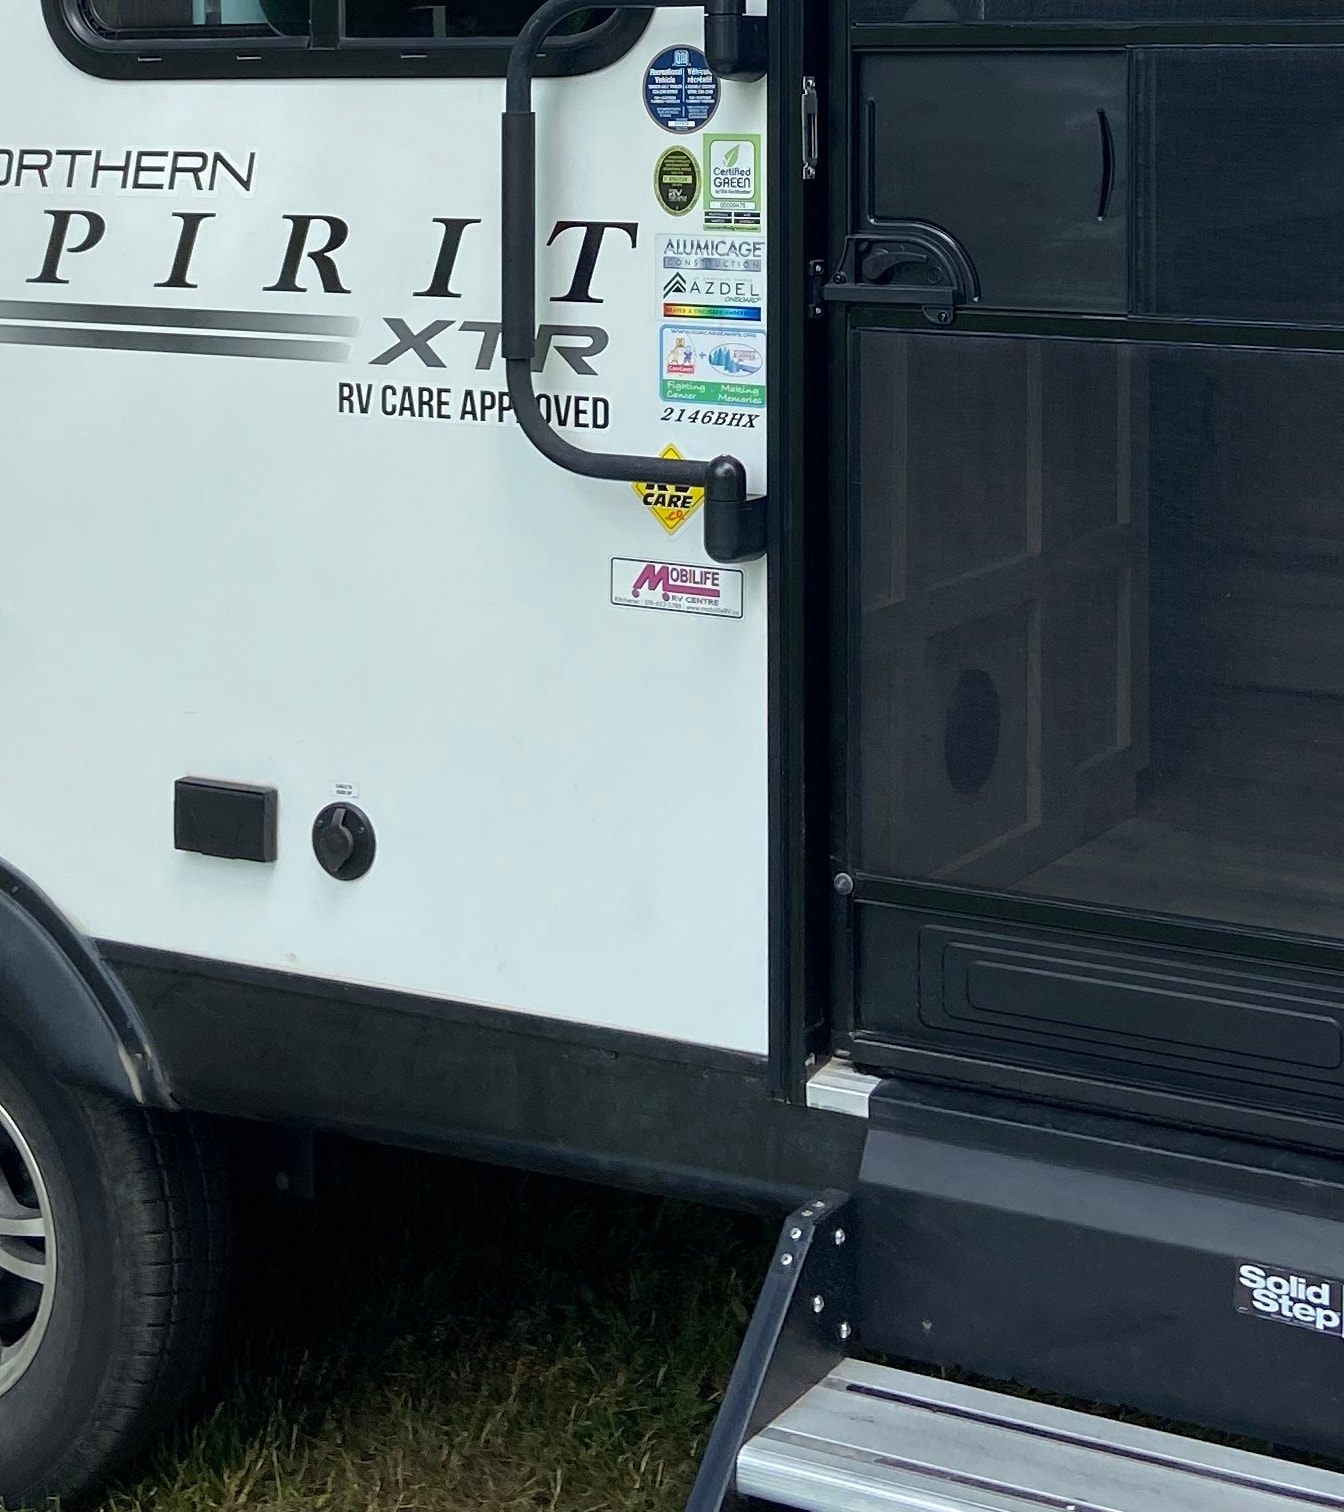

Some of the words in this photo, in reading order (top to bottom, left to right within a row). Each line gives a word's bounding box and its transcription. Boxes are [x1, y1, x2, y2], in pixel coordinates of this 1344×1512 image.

[713, 166, 751, 176] Certified
[713, 177, 751, 188] GREEN
[664, 239, 765, 257] ALUMICAGE
[667, 257, 760, 268] CONSTRUCTION
[689, 281, 759, 296] AZDEL
[368, 317, 609, 376] XTR
[667, 380, 706, 393] Fighting
[721, 384, 759, 396] Making
[667, 390, 696, 399] Cancer
[718, 393, 762, 404] Memories
[338, 382, 373, 414] RV
[381, 385, 451, 419] CARE
[460, 389, 609, 429] APPOVED
[660, 407, 760, 428] 2146BHX
[642, 493, 693, 509] CARE
[671, 595, 684, 603] RV
[686, 596, 719, 606] CENTRE
[1239, 1263, 1330, 1306] Solid
[1252, 1289, 1341, 1330] Step
